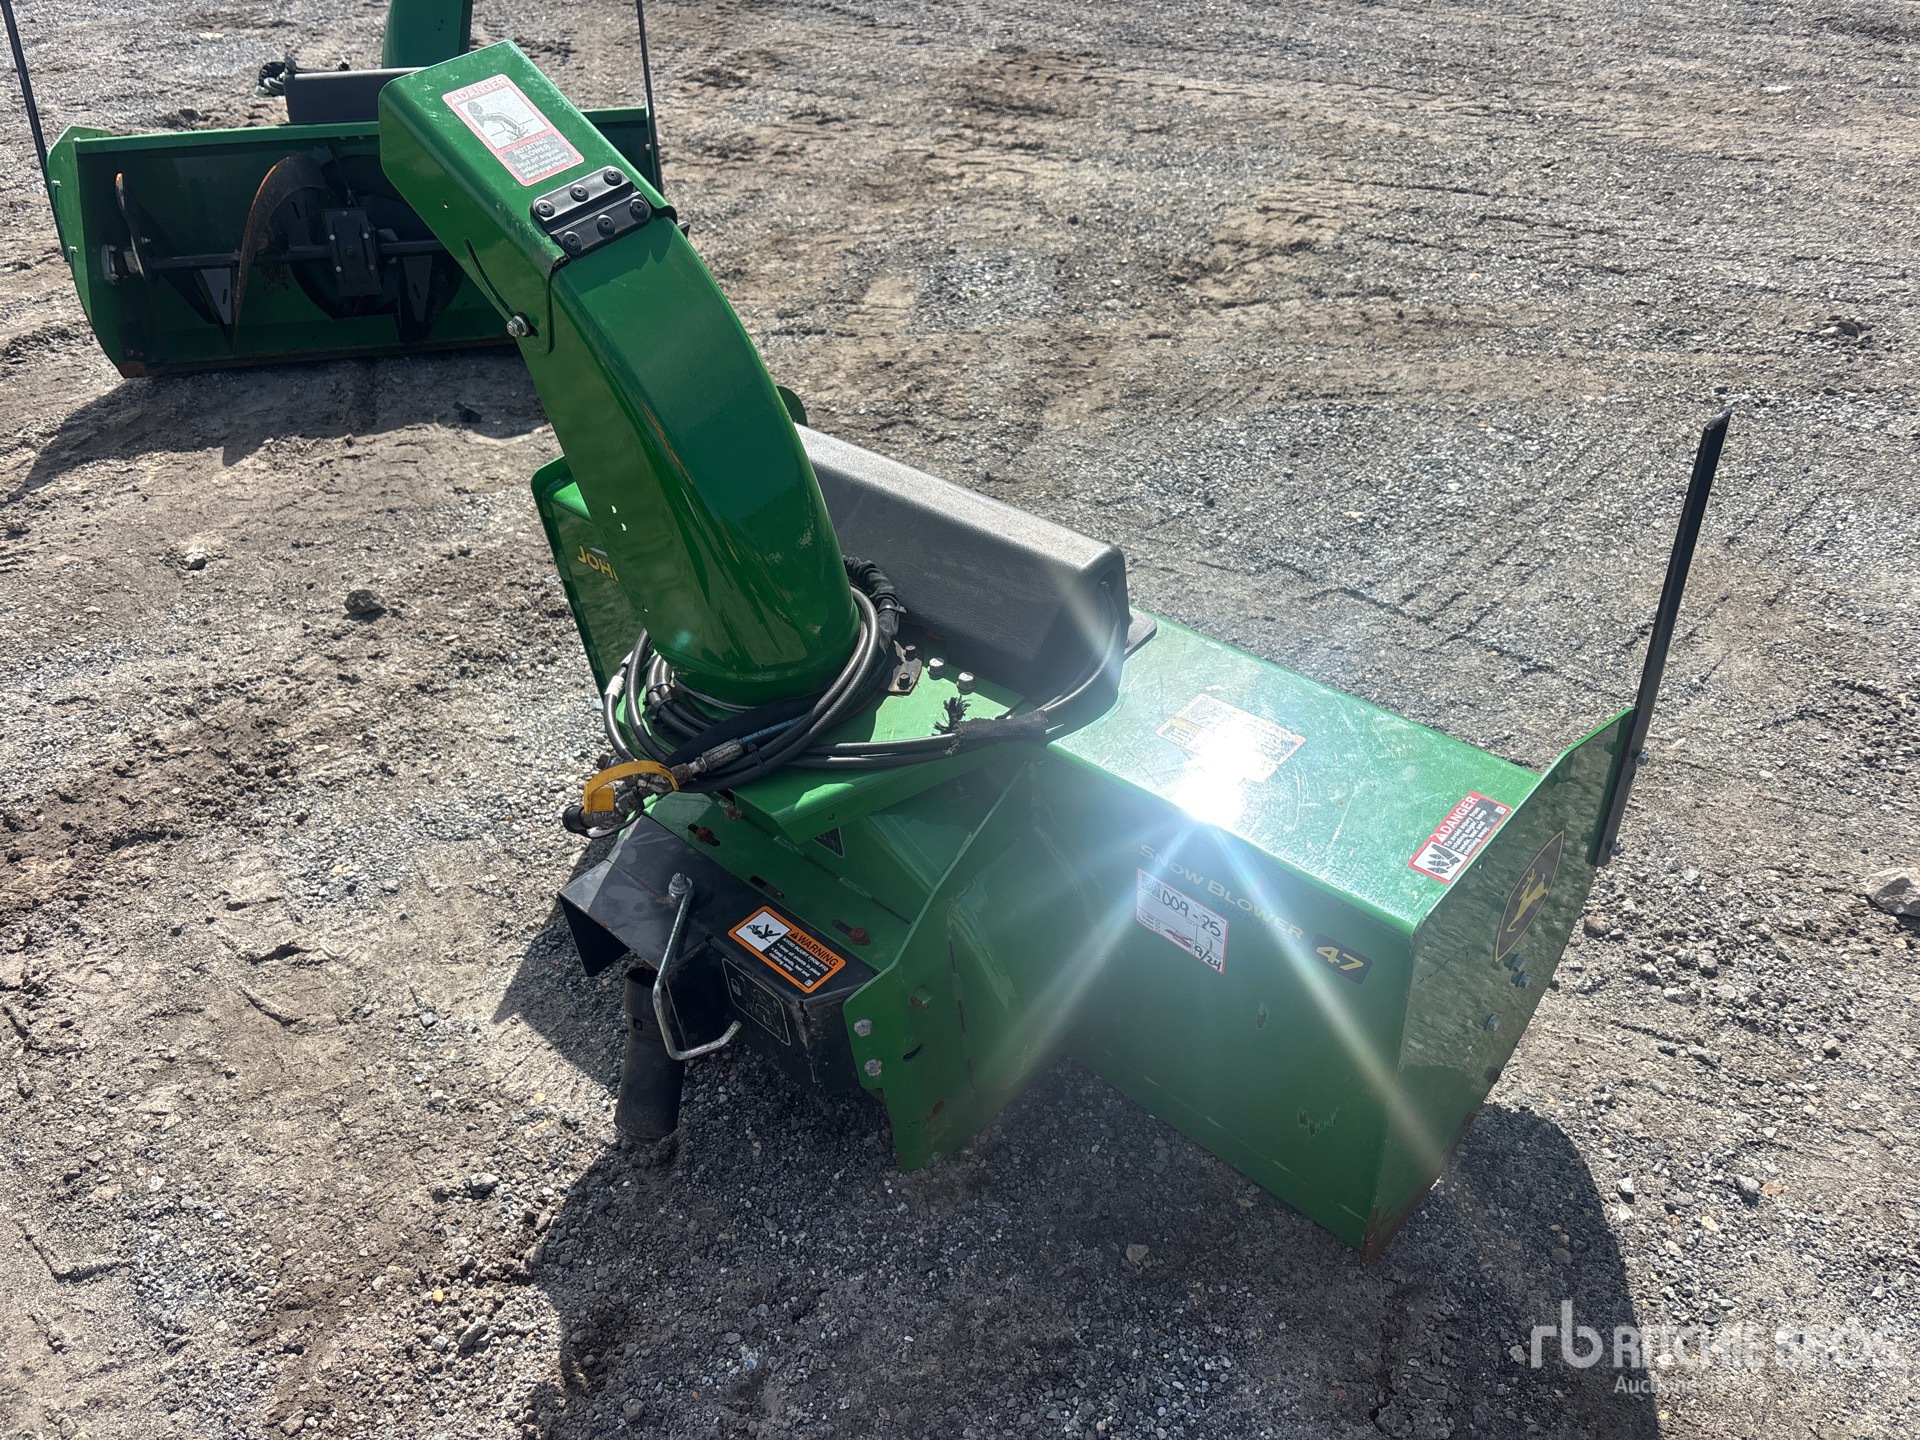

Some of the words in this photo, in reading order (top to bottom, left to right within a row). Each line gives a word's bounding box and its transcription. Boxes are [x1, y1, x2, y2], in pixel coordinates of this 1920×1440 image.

[459, 77, 508, 100] DANGER
[512, 138, 548, 156] ROTATING
[519, 143, 551, 160] BLOWER
[578, 545, 619, 581] JOH
[1440, 796, 1480, 835] DANGER
[1450, 828, 1462, 841] avoid
[1459, 816, 1473, 830] injury
[1469, 807, 1481, 817] from
[1451, 832, 1469, 850] rotating
[1475, 809, 1487, 820] keep
[1469, 829, 1479, 838] feet
[1476, 820, 1486, 830] and
[1463, 837, 1482, 855] clothing
[1207, 879, 1304, 939] BLOWER
[768, 952, 785, 966] clothing
[782, 963, 794, 972] away
[773, 948, 784, 958] Keep
[782, 955, 795, 967] hands,
[794, 964, 803, 972] feet
[801, 970, 811, 978] and
[779, 944, 790, 953] Keep
[793, 955, 807, 966] shields
[809, 967, 821, 977] place
[782, 937, 796, 948] AVOID
[794, 945, 809, 958] INJURY
[807, 955, 820, 966] FROM
[819, 963, 829, 972] PTO
[797, 935, 839, 967] WARNING
[1315, 946, 1365, 971] 47
